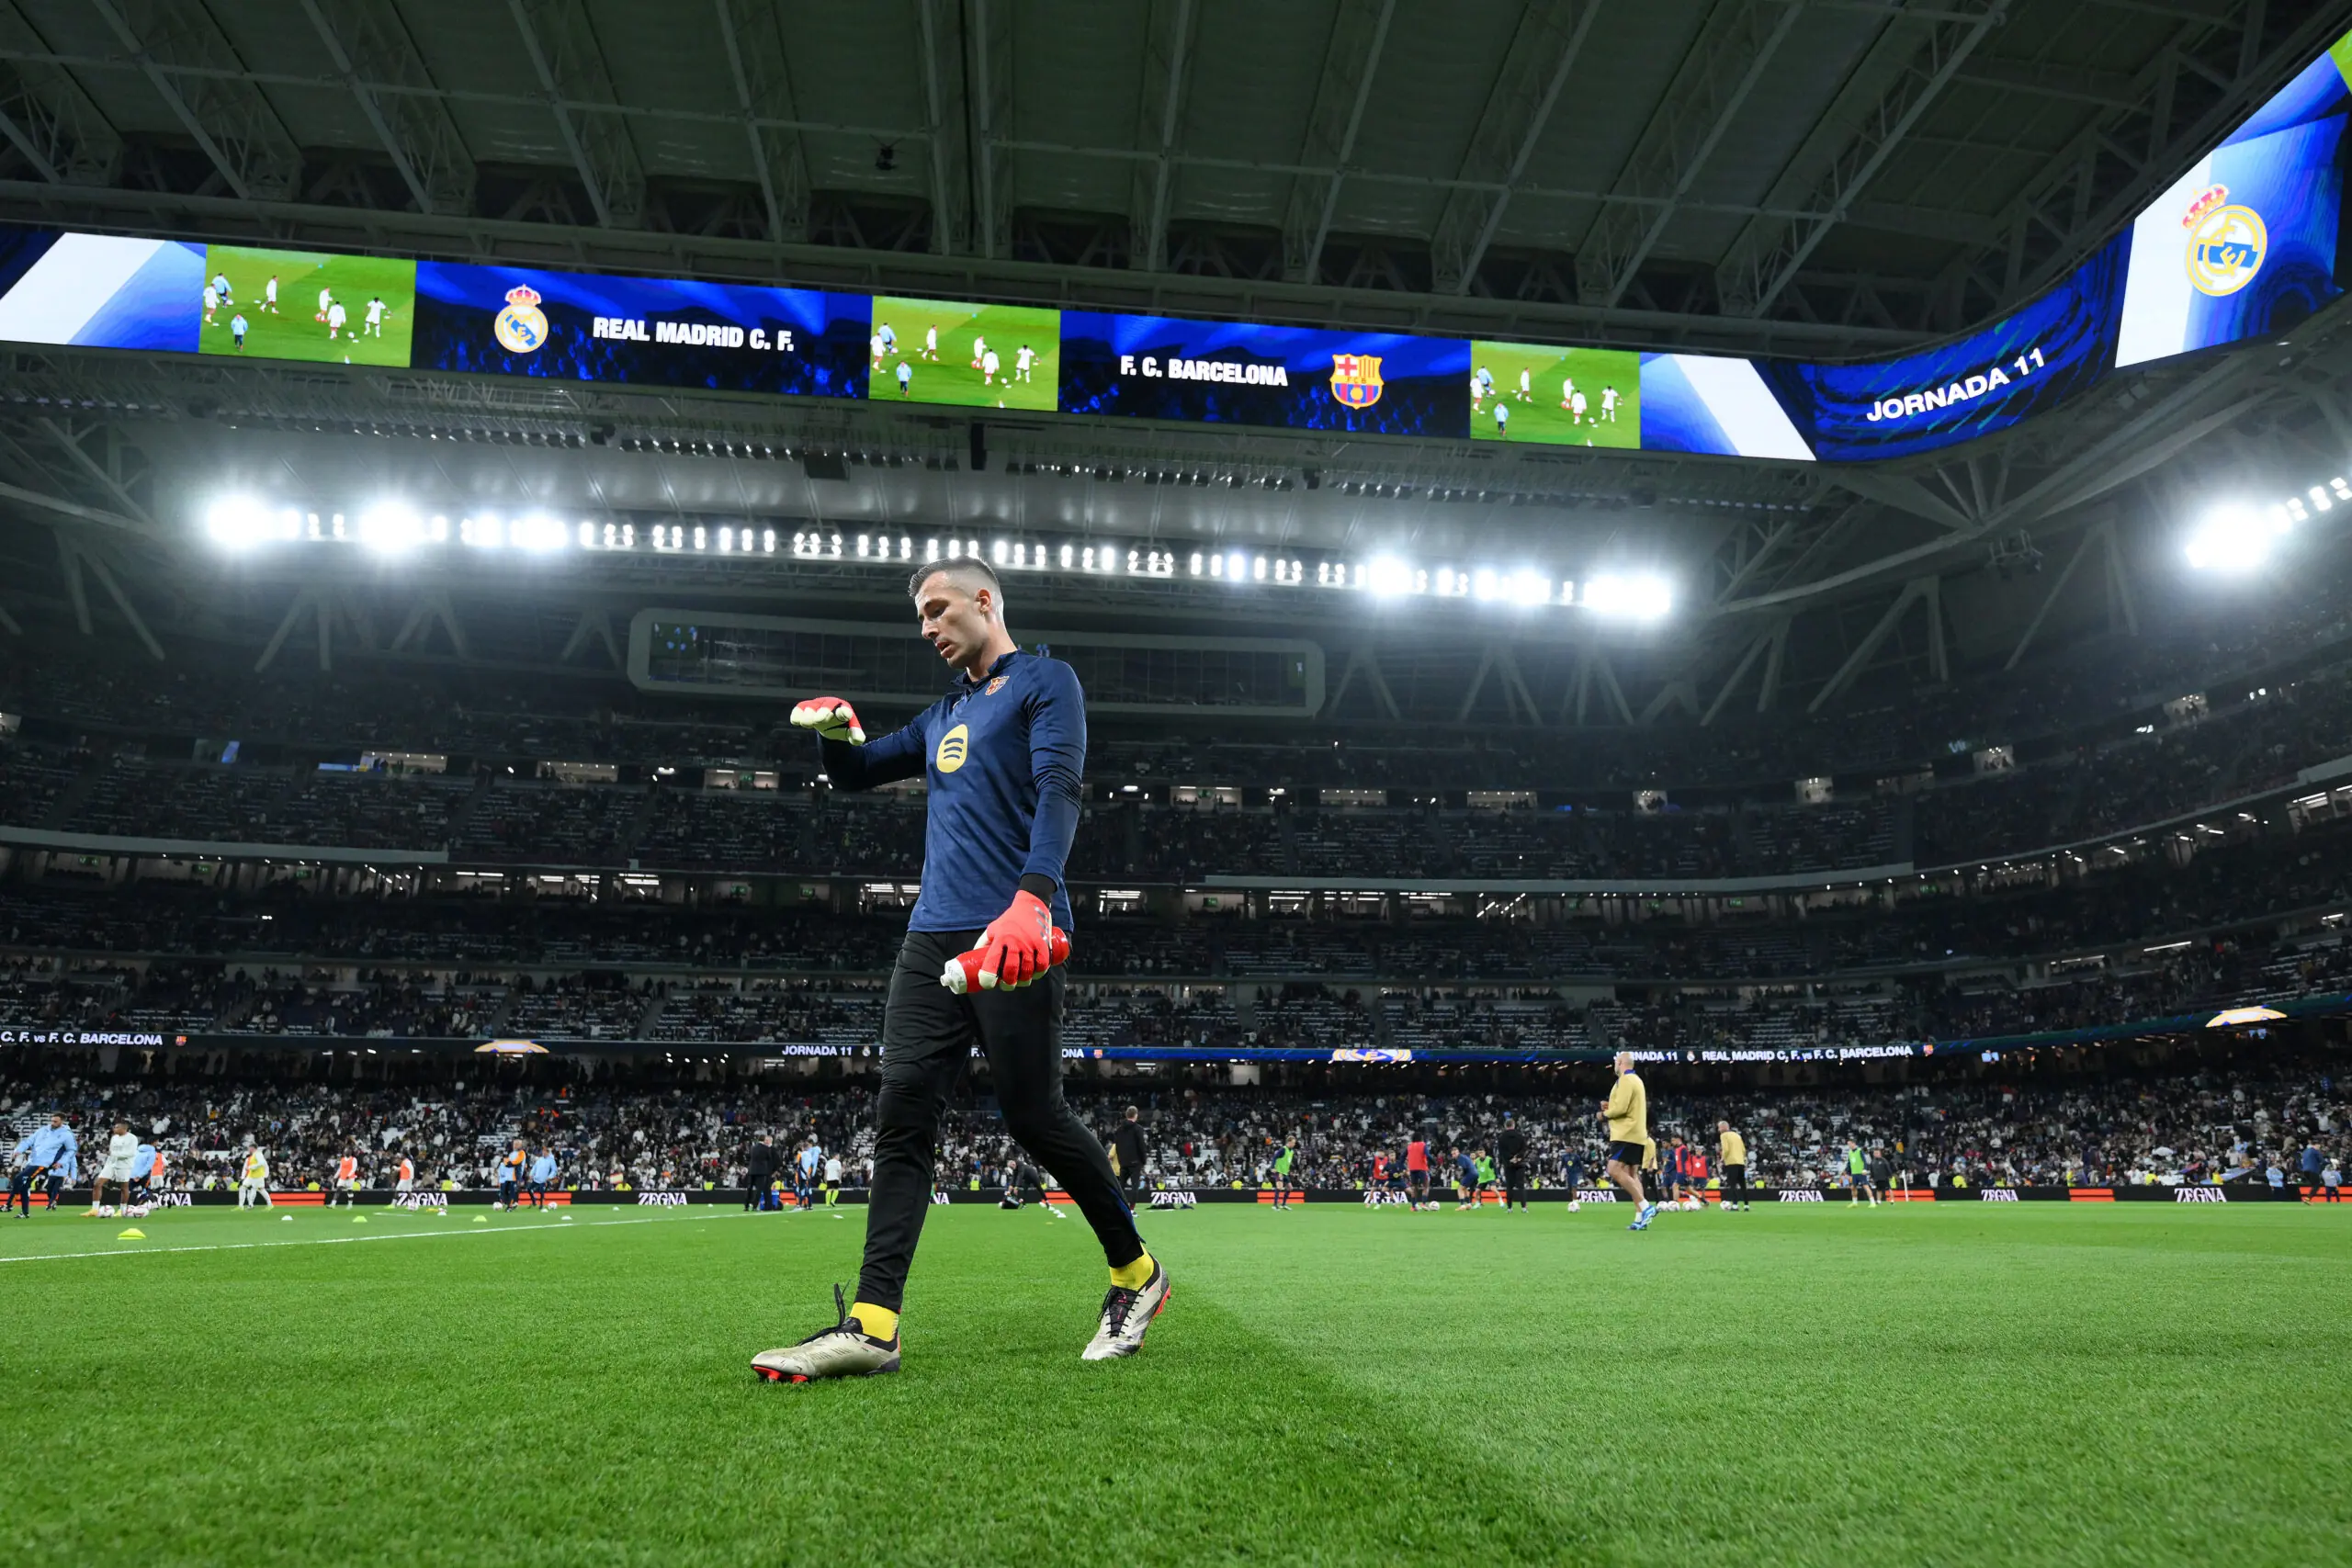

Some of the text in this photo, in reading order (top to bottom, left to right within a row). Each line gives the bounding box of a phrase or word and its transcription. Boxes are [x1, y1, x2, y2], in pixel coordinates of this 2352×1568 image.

[593, 317, 795, 351] REAL MADRID C. F.
[1121, 355, 1288, 387] F. C. BARCELONA
[1866, 347, 2045, 423] JORNADA 11
[18, 1032, 29, 1043] F.
[34, 1034, 45, 1043] vs
[49, 1032, 59, 1043] F.
[62, 1032, 76, 1043] C.
[80, 1033, 163, 1045] BARCELONA
[782, 1045, 837, 1055] JORNADA
[840, 1046, 852, 1055] 11
[1666, 1051, 1678, 1061] 11
[1702, 1051, 1729, 1061] REAL
[1731, 1051, 1775, 1061] MADRID
[1791, 1050, 1800, 1060] F.
[1814, 1049, 1824, 1059] F.
[1826, 1048, 1838, 1059] C.
[1840, 1045, 1913, 1058] BARCELONA
[638, 1192, 687, 1205] ZEGNA
[1150, 1191, 1197, 1203] ZEGNA
[1779, 1190, 1824, 1202] ZEGNA
[1981, 1189, 2018, 1201] ZEGNA
[2174, 1187, 2227, 1202] ZEGNA
